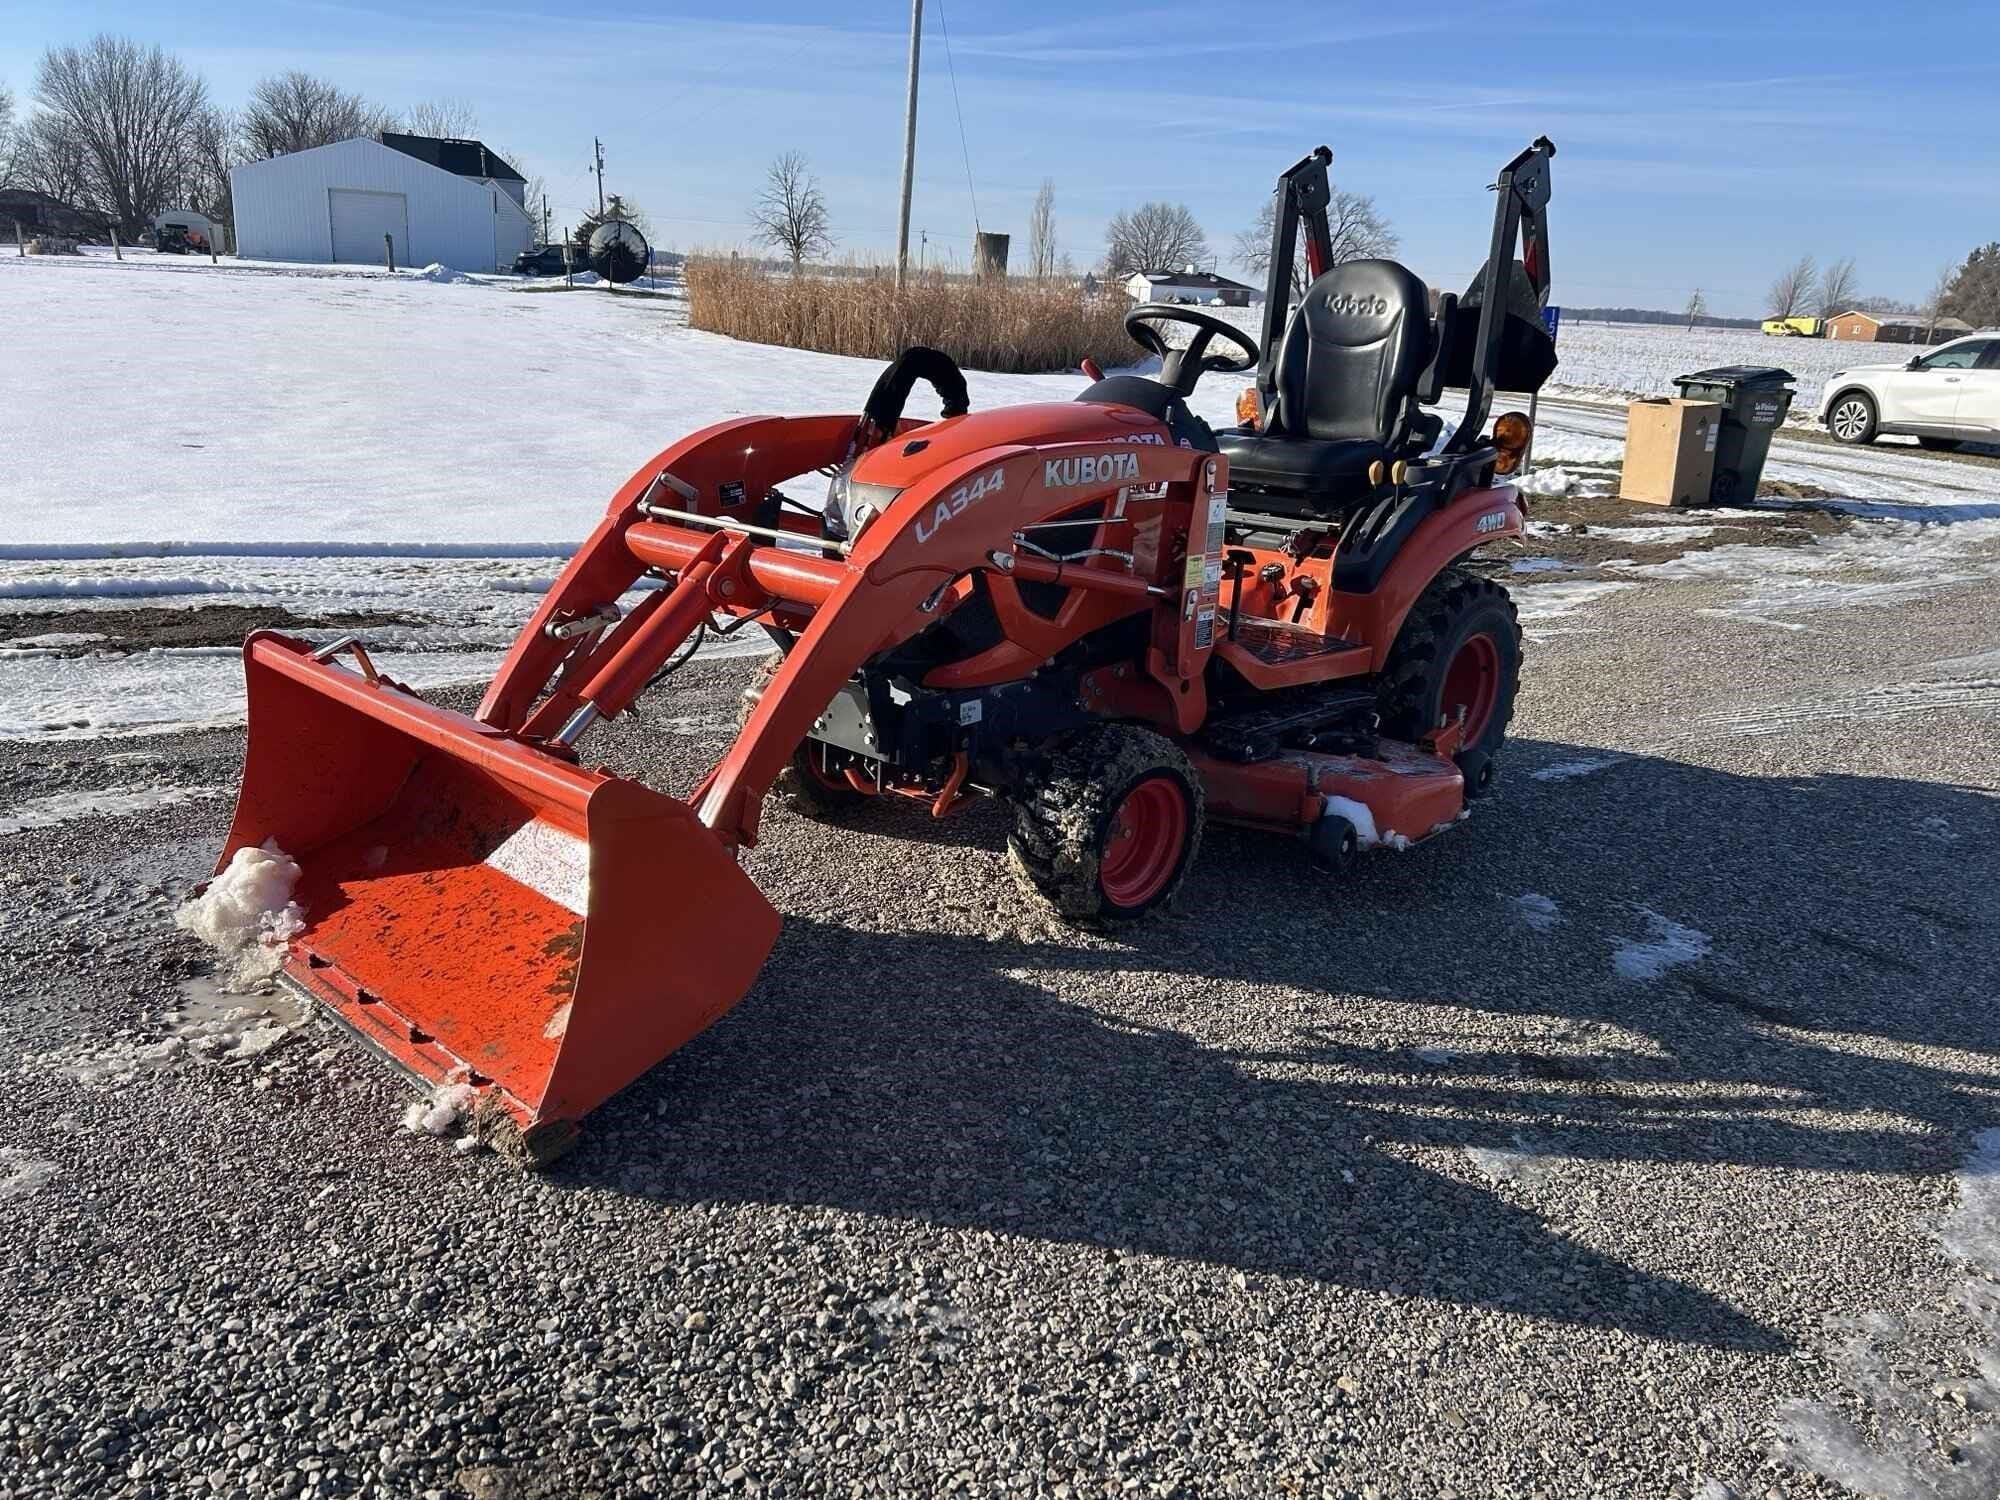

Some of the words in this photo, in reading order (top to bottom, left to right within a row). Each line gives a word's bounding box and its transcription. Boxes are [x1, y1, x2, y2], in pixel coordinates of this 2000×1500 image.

[1322, 293, 1387, 316] Kubota
[1045, 453, 1141, 488] KUBOTA
[914, 468, 1005, 544] LA344
[1476, 511, 1506, 533] 4WD
